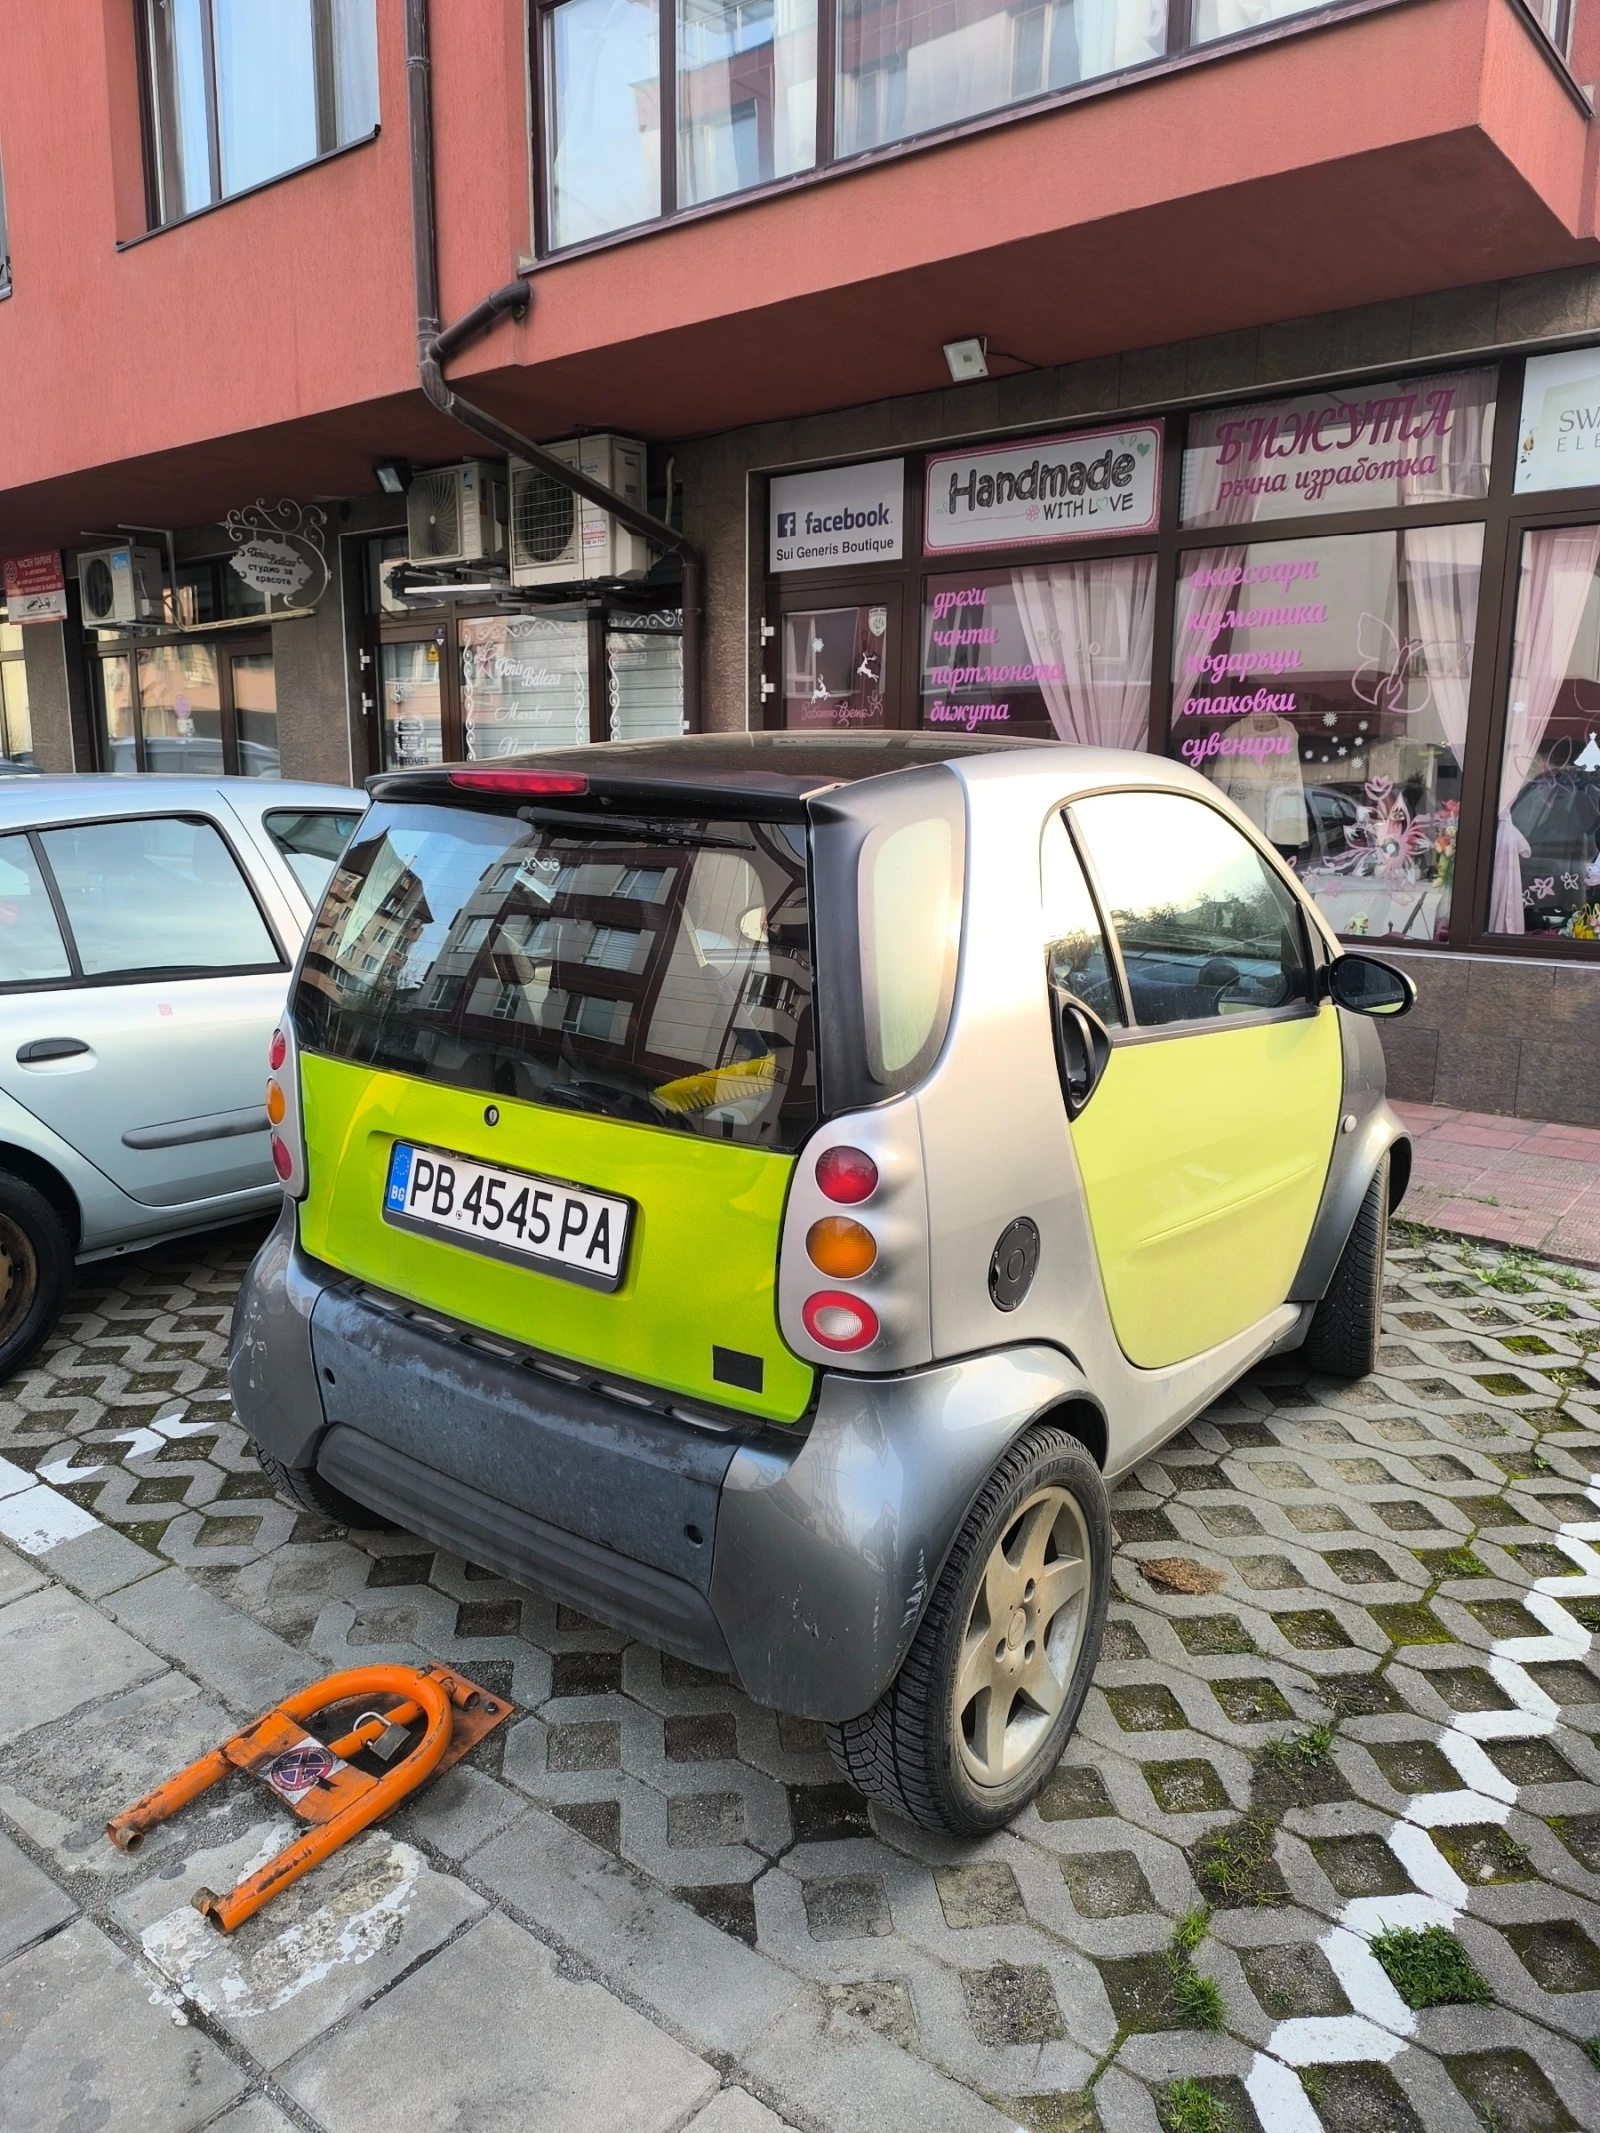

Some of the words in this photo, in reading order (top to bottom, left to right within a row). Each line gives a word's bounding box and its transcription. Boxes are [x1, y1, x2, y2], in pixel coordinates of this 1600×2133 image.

[1215, 389, 1456, 465] БИЖУТА
[948, 449, 1136, 514] Handmade
[1216, 473, 1287, 511] ръчна
[1294, 453, 1438, 501] изработка
[805, 502, 890, 535] facebook
[1043, 497, 1084, 520] WITH
[776, 547, 794, 561] Sui
[796, 543, 839, 559] Generis
[842, 538, 894, 553] Boutique
[248, 564, 280, 574] студио
[283, 568, 293, 576] за
[256, 575, 291, 585] красота
[1188, 559, 1320, 594] аксесоари
[933, 587, 989, 620] дрехи
[933, 627, 998, 647] чанти
[1186, 603, 1328, 641] козметика
[521, 666, 562, 687] Belleza
[931, 663, 1066, 694] портмонета
[1184, 649, 1303, 684] подаръци
[930, 701, 1010, 731] бижута
[1183, 688, 1297, 715] опаковки
[1181, 732, 1292, 768] сувенири
[391, 1184, 406, 1202] BG
